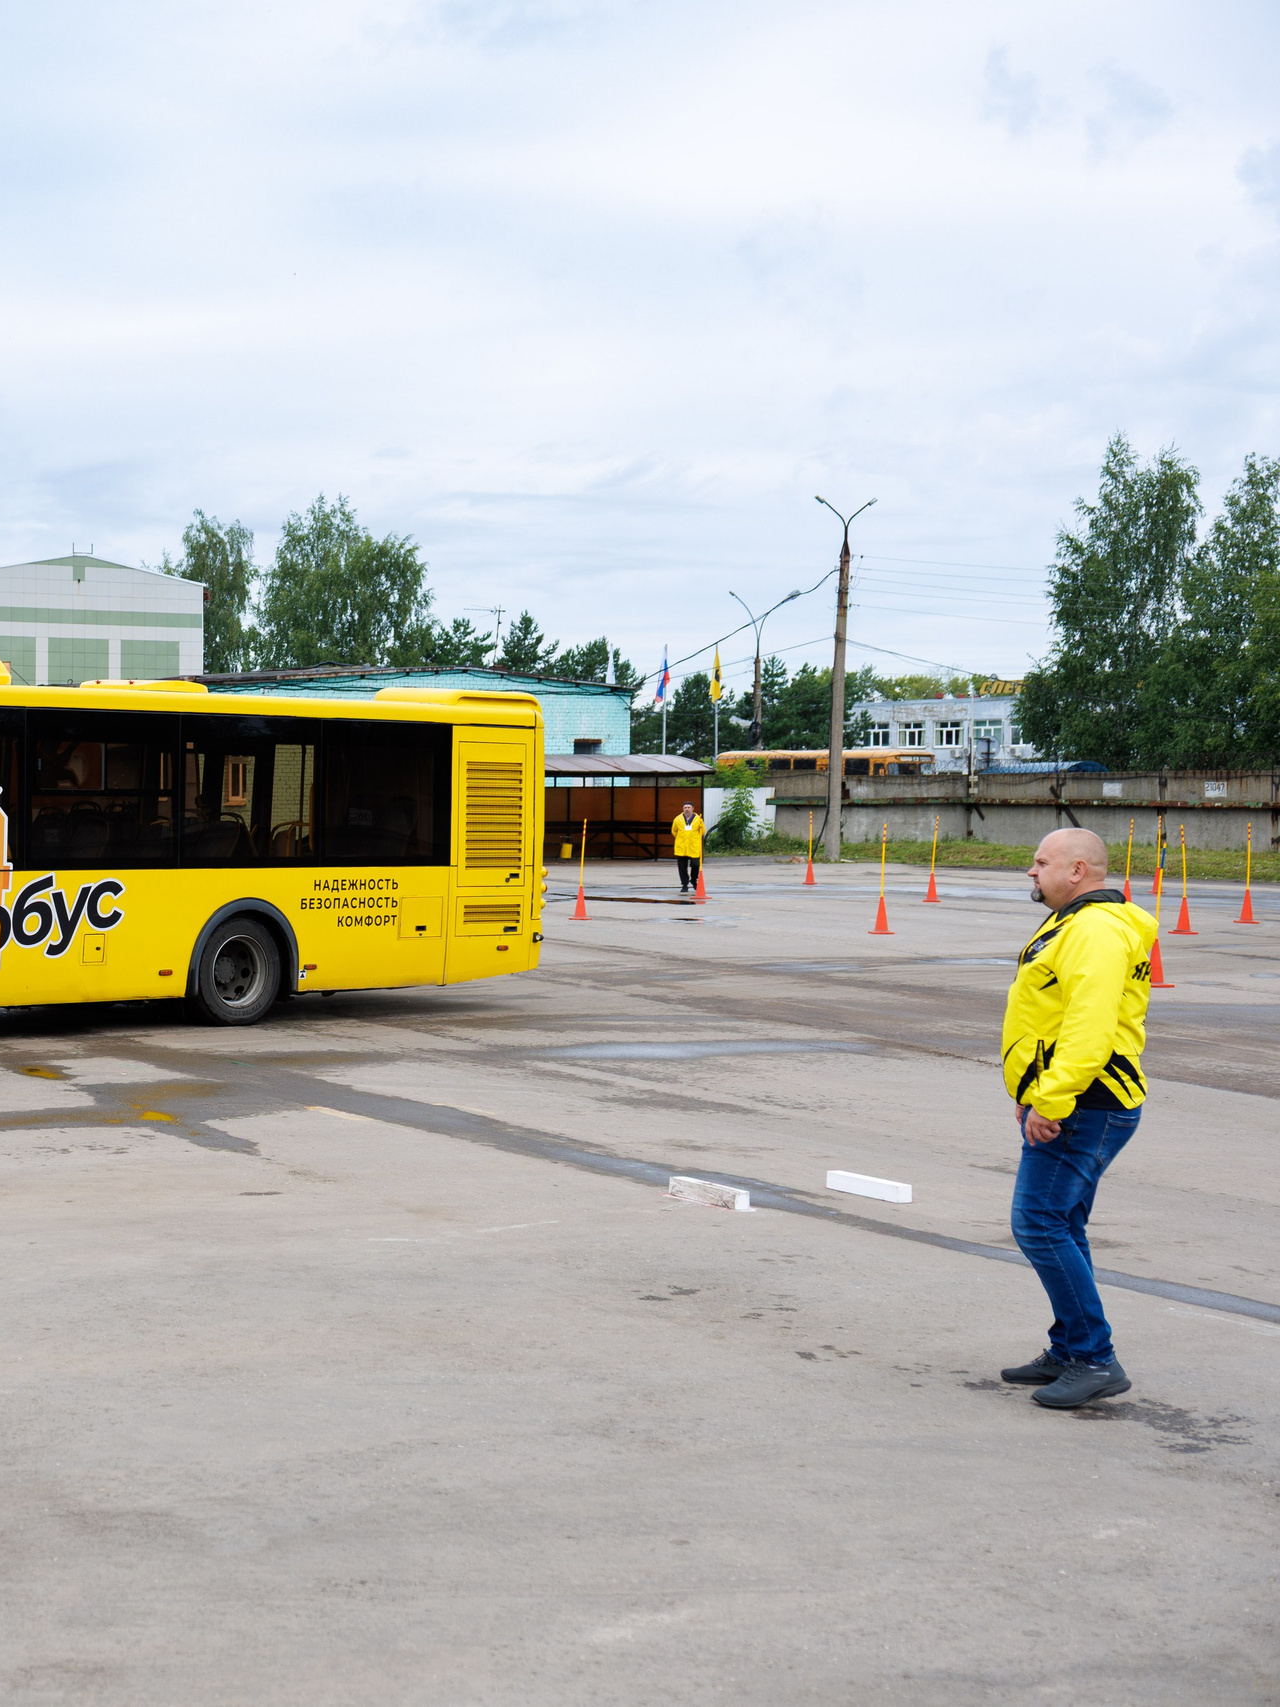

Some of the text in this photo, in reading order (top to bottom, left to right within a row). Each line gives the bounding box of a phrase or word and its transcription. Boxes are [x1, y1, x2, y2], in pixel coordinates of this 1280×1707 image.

[313, 878, 399, 893] НАДЕЖНОСТЬ
[300, 897, 399, 910] БЕЗОПАСНОСТЬ
[337, 914, 398, 928] КОМФОРТ
[1131, 960, 1152, 984] ЯР
